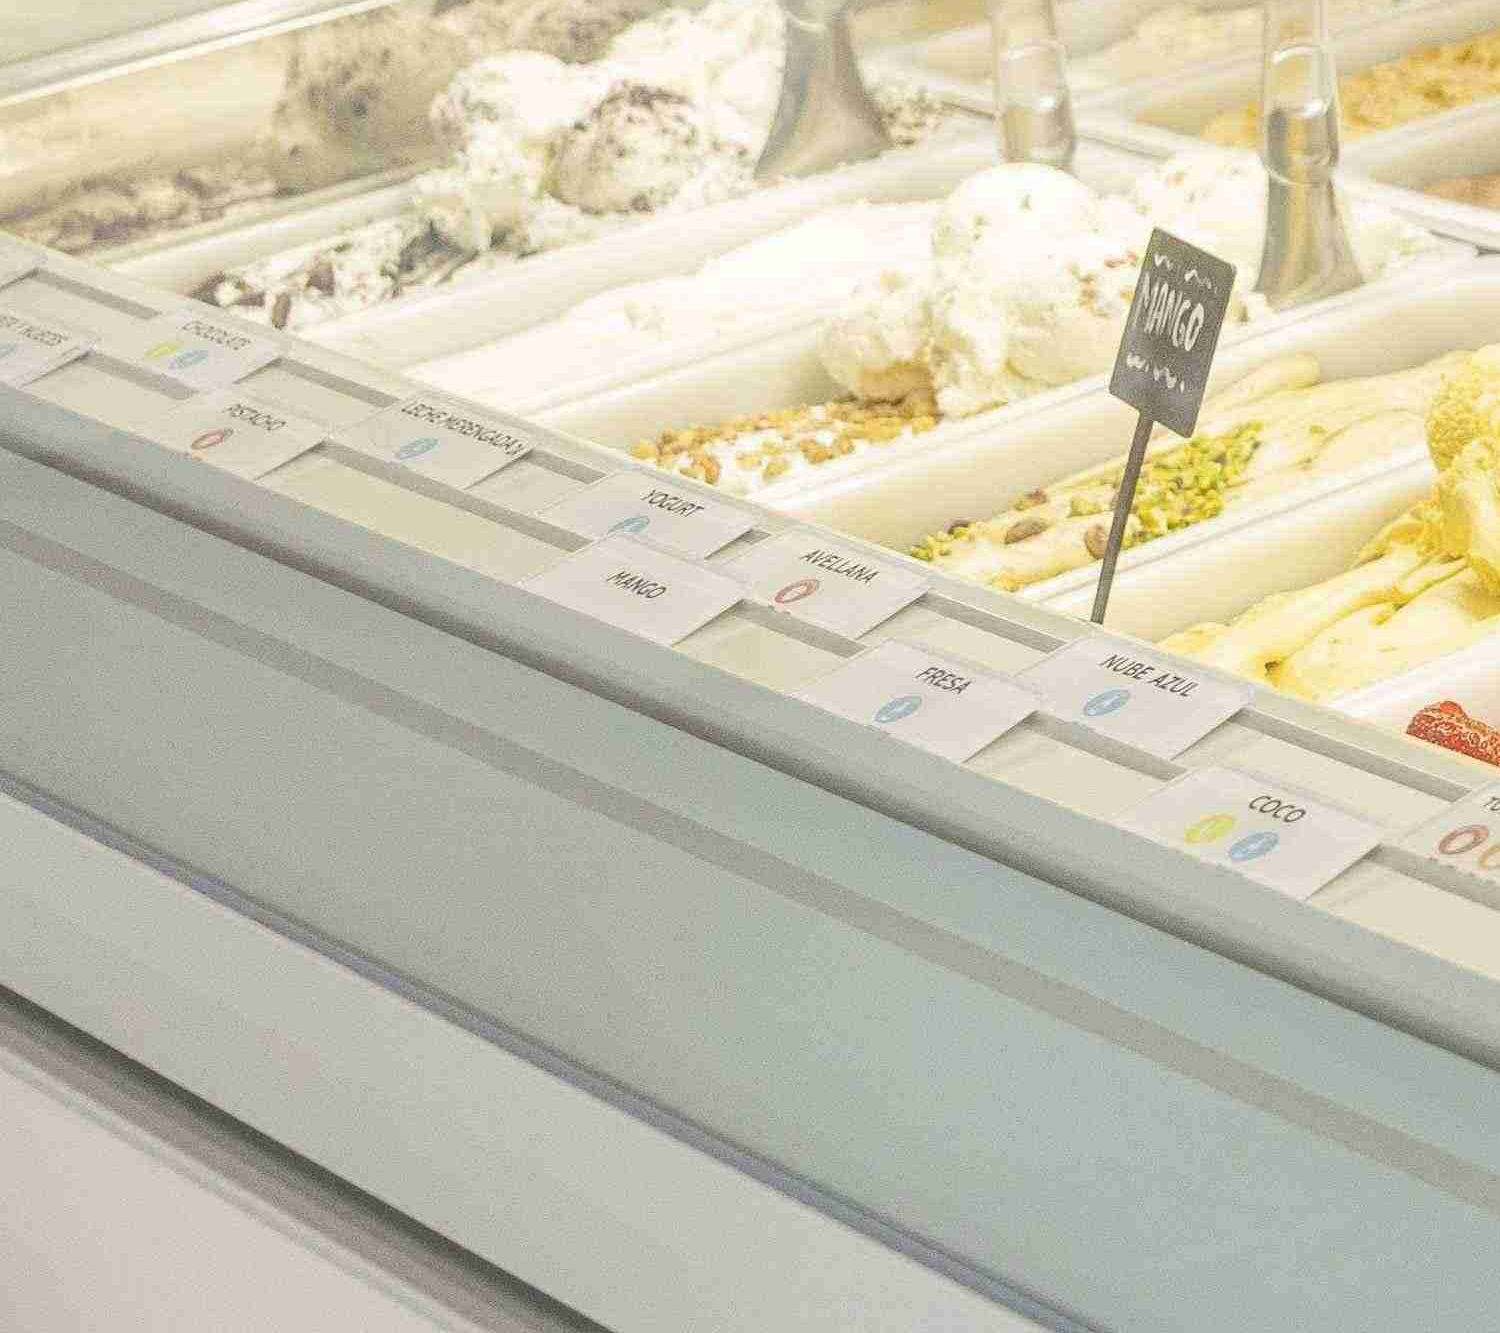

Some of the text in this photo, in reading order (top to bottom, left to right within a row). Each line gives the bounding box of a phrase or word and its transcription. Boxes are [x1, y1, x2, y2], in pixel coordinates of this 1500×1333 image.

[1134, 271, 1205, 352] MANGO
[640, 488, 705, 518] YOGURT
[801, 548, 880, 586] AVELLANA
[606, 569, 668, 600] MANGO
[915, 666, 974, 696] FRESA
[1100, 653, 1202, 699] NUBE AZUL
[1247, 793, 1308, 825] COCO
